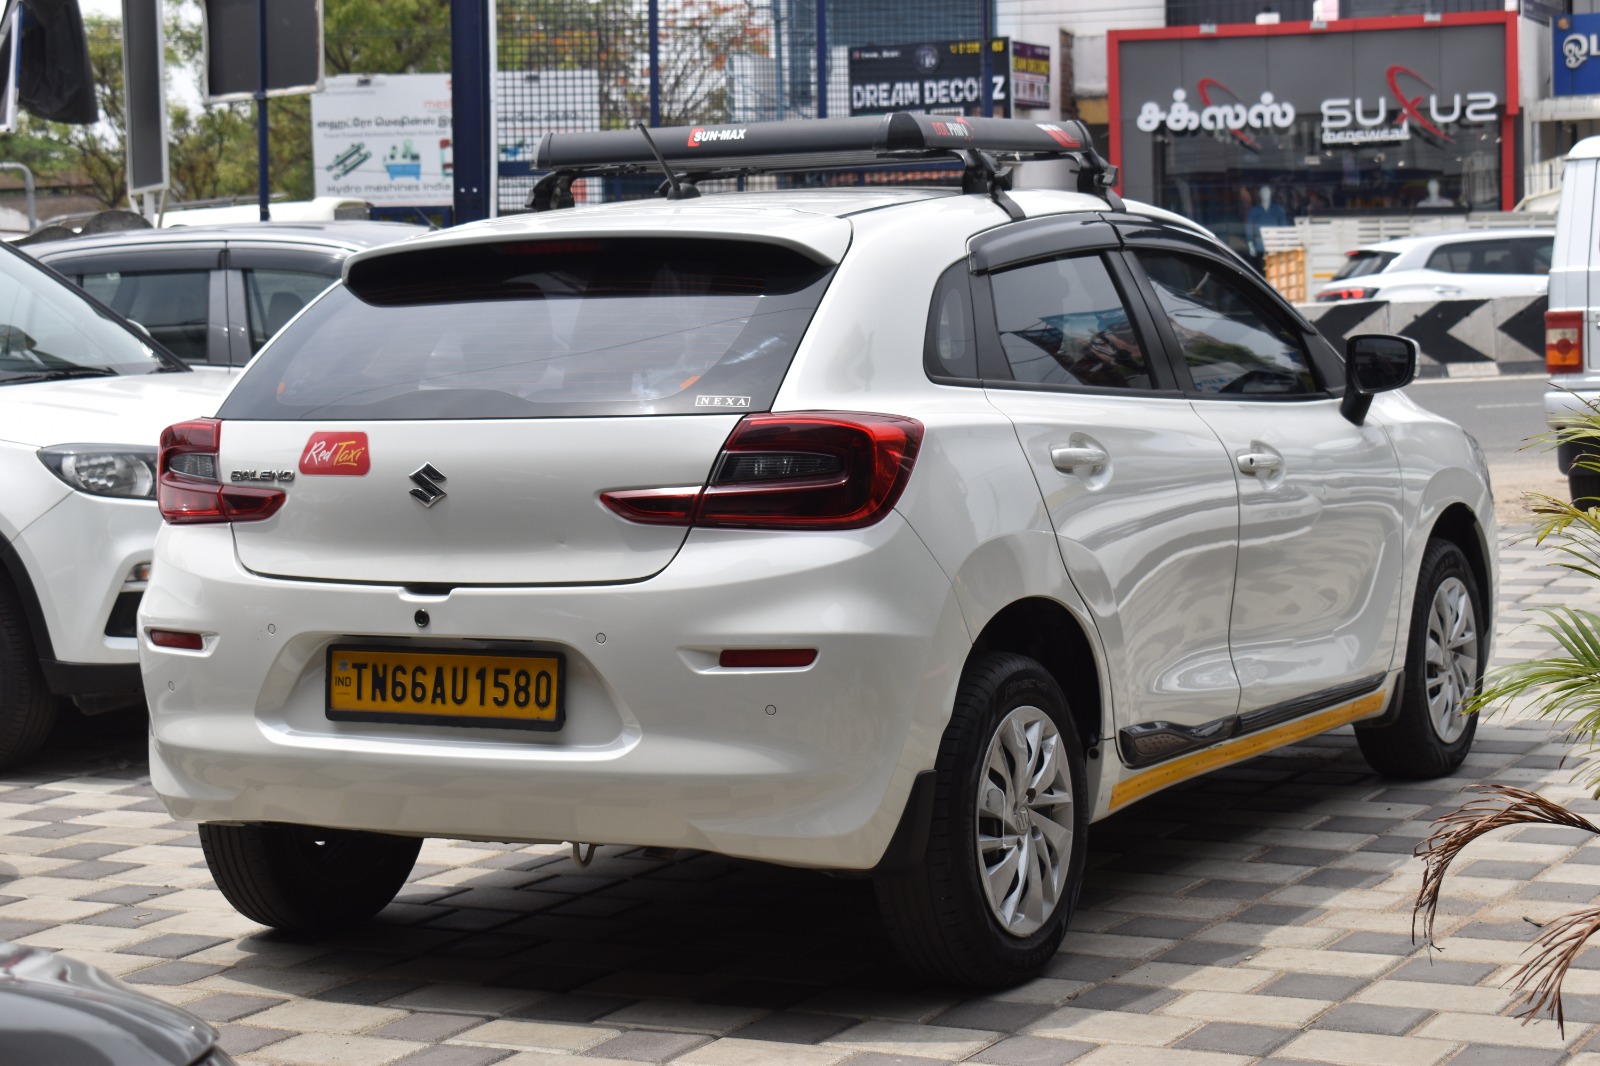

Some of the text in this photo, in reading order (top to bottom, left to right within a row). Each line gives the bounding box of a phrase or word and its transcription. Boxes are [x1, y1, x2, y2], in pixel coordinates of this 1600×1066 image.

[852, 75, 1006, 109] DREAM DECOZ
[1136, 88, 1295, 132] சக்ஸஸ்
[693, 128, 746, 143] SUN-MAX
[1322, 128, 1410, 144] menswear
[327, 184, 363, 195] Hydro
[700, 397, 746, 406] NEXA
[304, 440, 365, 466] Red Taxi
[230, 469, 295, 482] BALENO
[334, 675, 351, 687] IND
[351, 662, 551, 709] TN66AU1580
